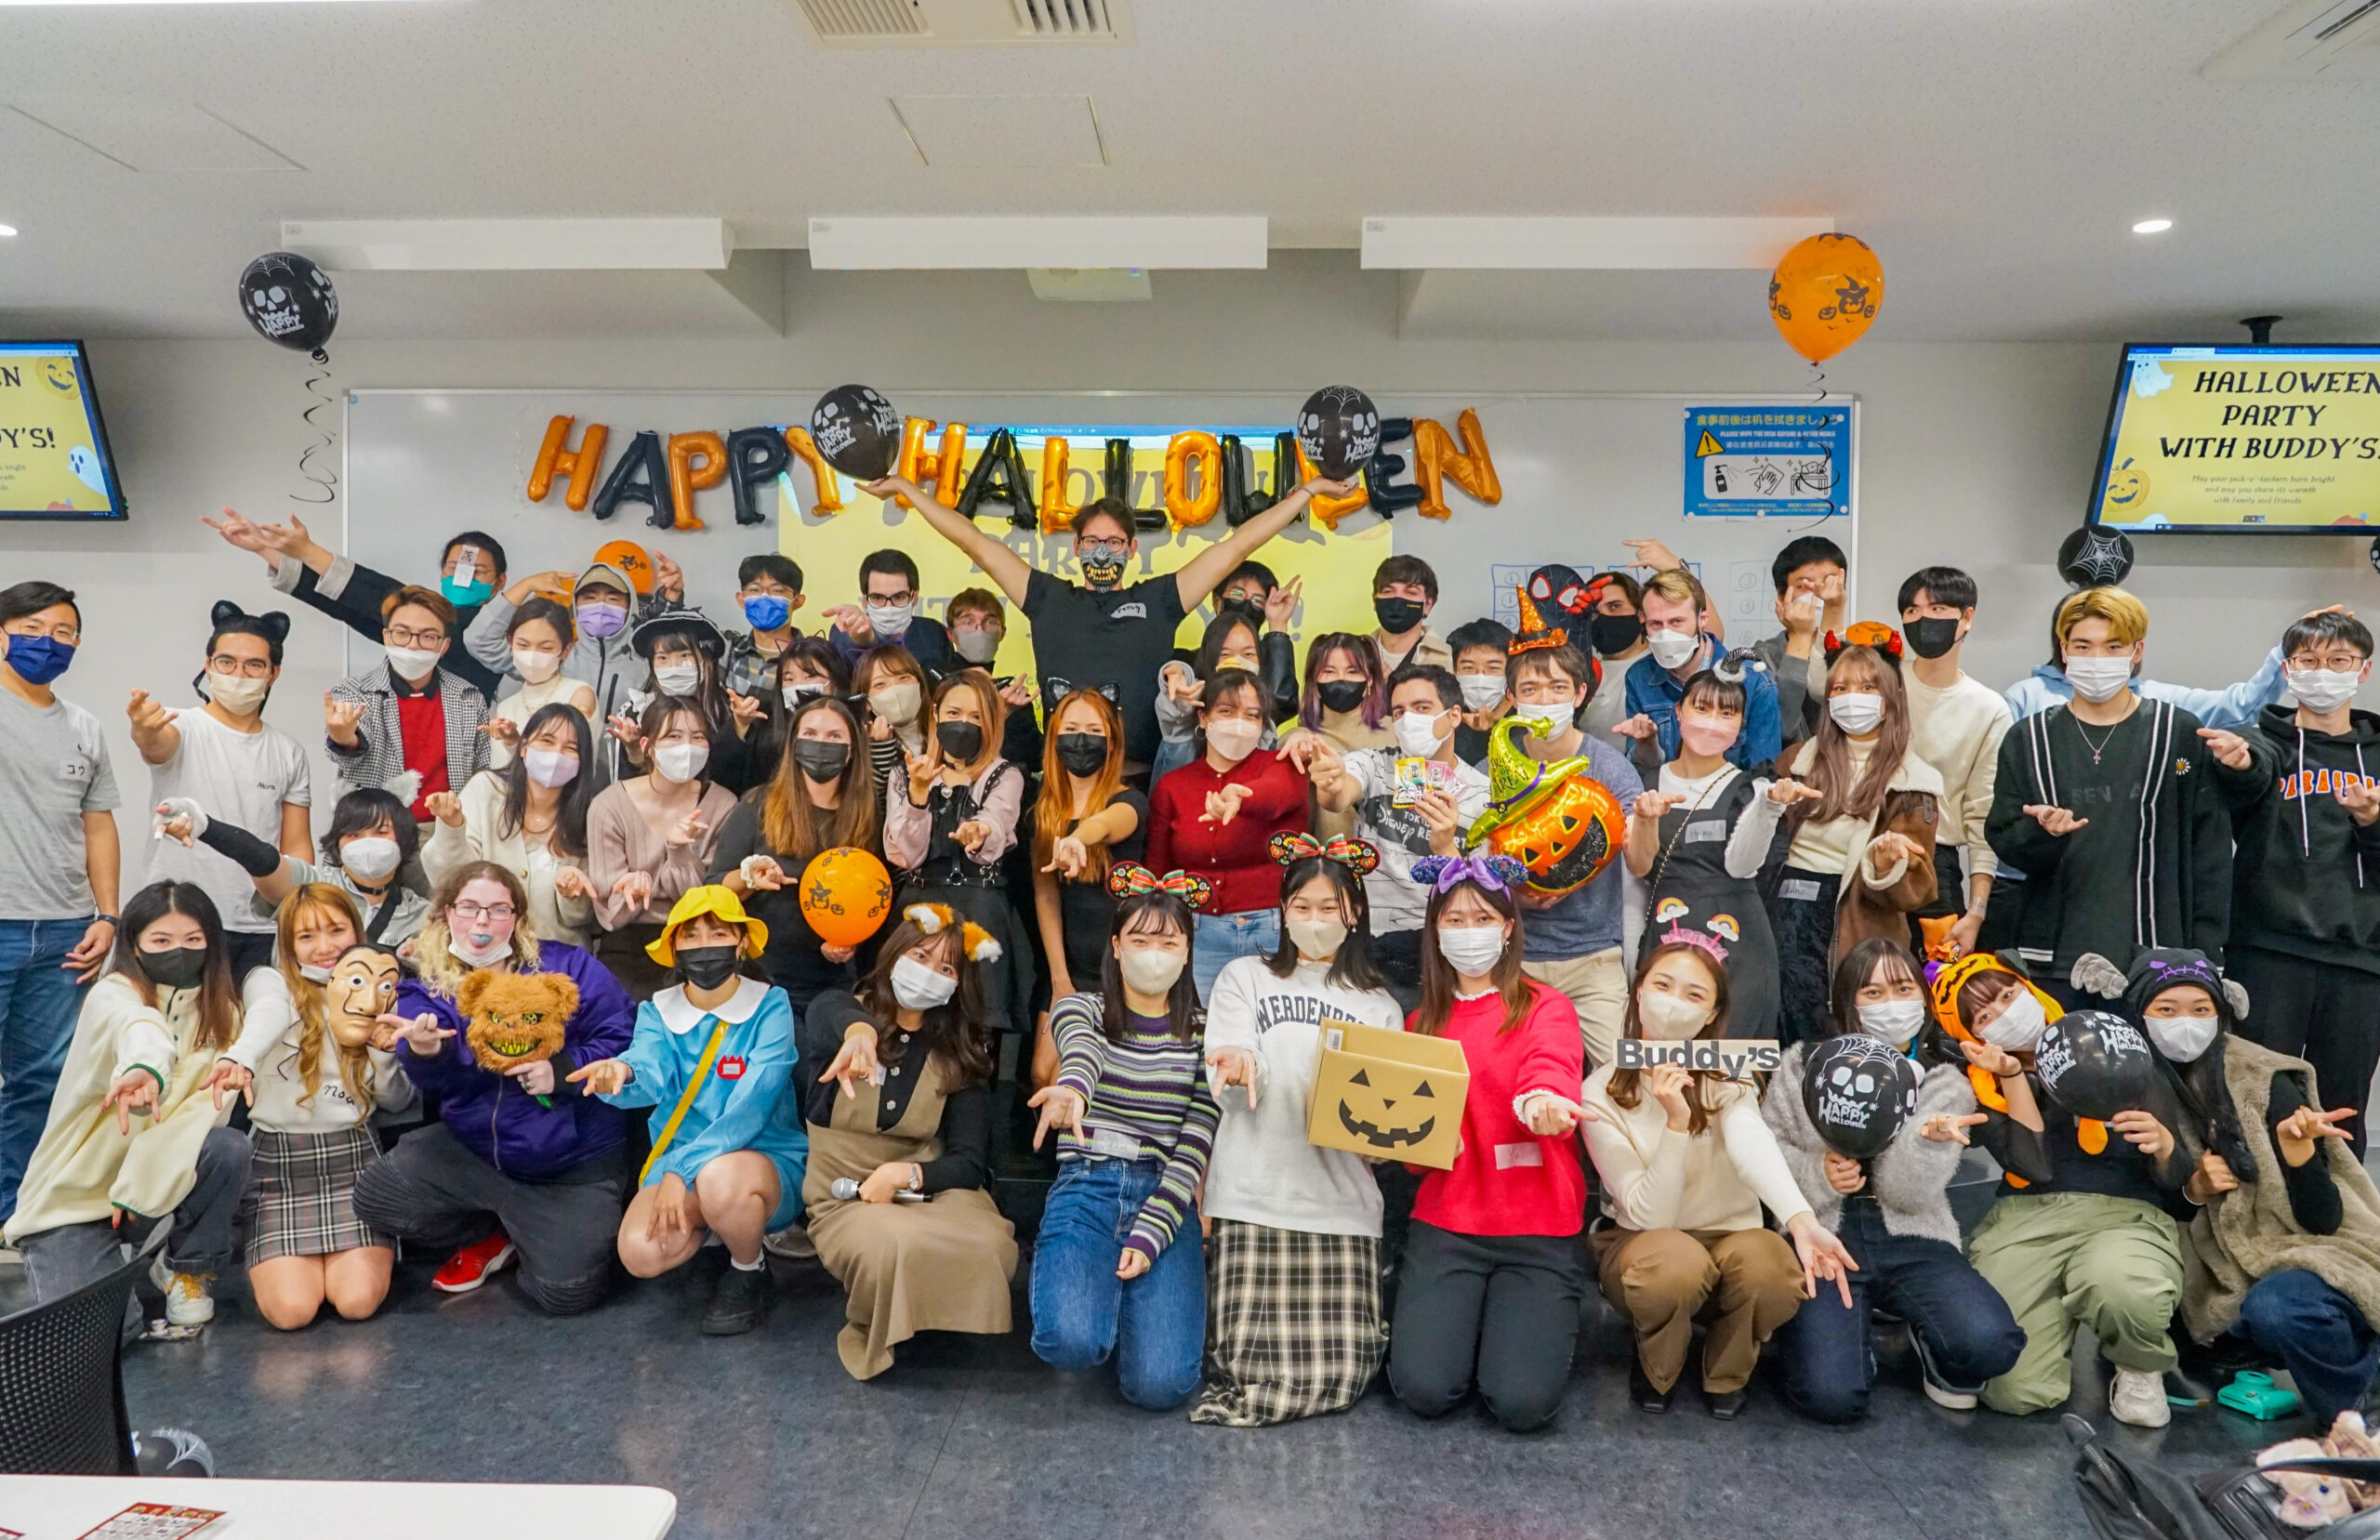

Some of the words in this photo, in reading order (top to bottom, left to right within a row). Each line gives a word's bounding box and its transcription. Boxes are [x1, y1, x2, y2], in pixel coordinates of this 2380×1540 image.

[0, 366, 21, 387] N
[2193, 371, 2380, 394] HALLOWEEN
[2221, 404, 2327, 427] PARTY
[818, 427, 852, 461] HAPPY
[2160, 437, 2237, 458] WITH
[2242, 437, 2380, 460] BUDDY'S
[527, 414, 843, 531] HAPPY
[2311, 475, 2335, 483] bright
[2232, 496, 2255, 505] family
[2280, 768, 2380, 800] ARAGRA
[1417, 826, 1467, 849] RERT
[1257, 994, 1366, 1034] WERDEN
[2099, 1028, 2144, 1055] HAPPY
[1617, 1039, 1781, 1082] Buddy's
[2038, 1047, 2072, 1093] HAPPY
[1818, 1096, 1871, 1125] HAPPY
[1829, 1115, 1867, 1129] HALLOWEEN
